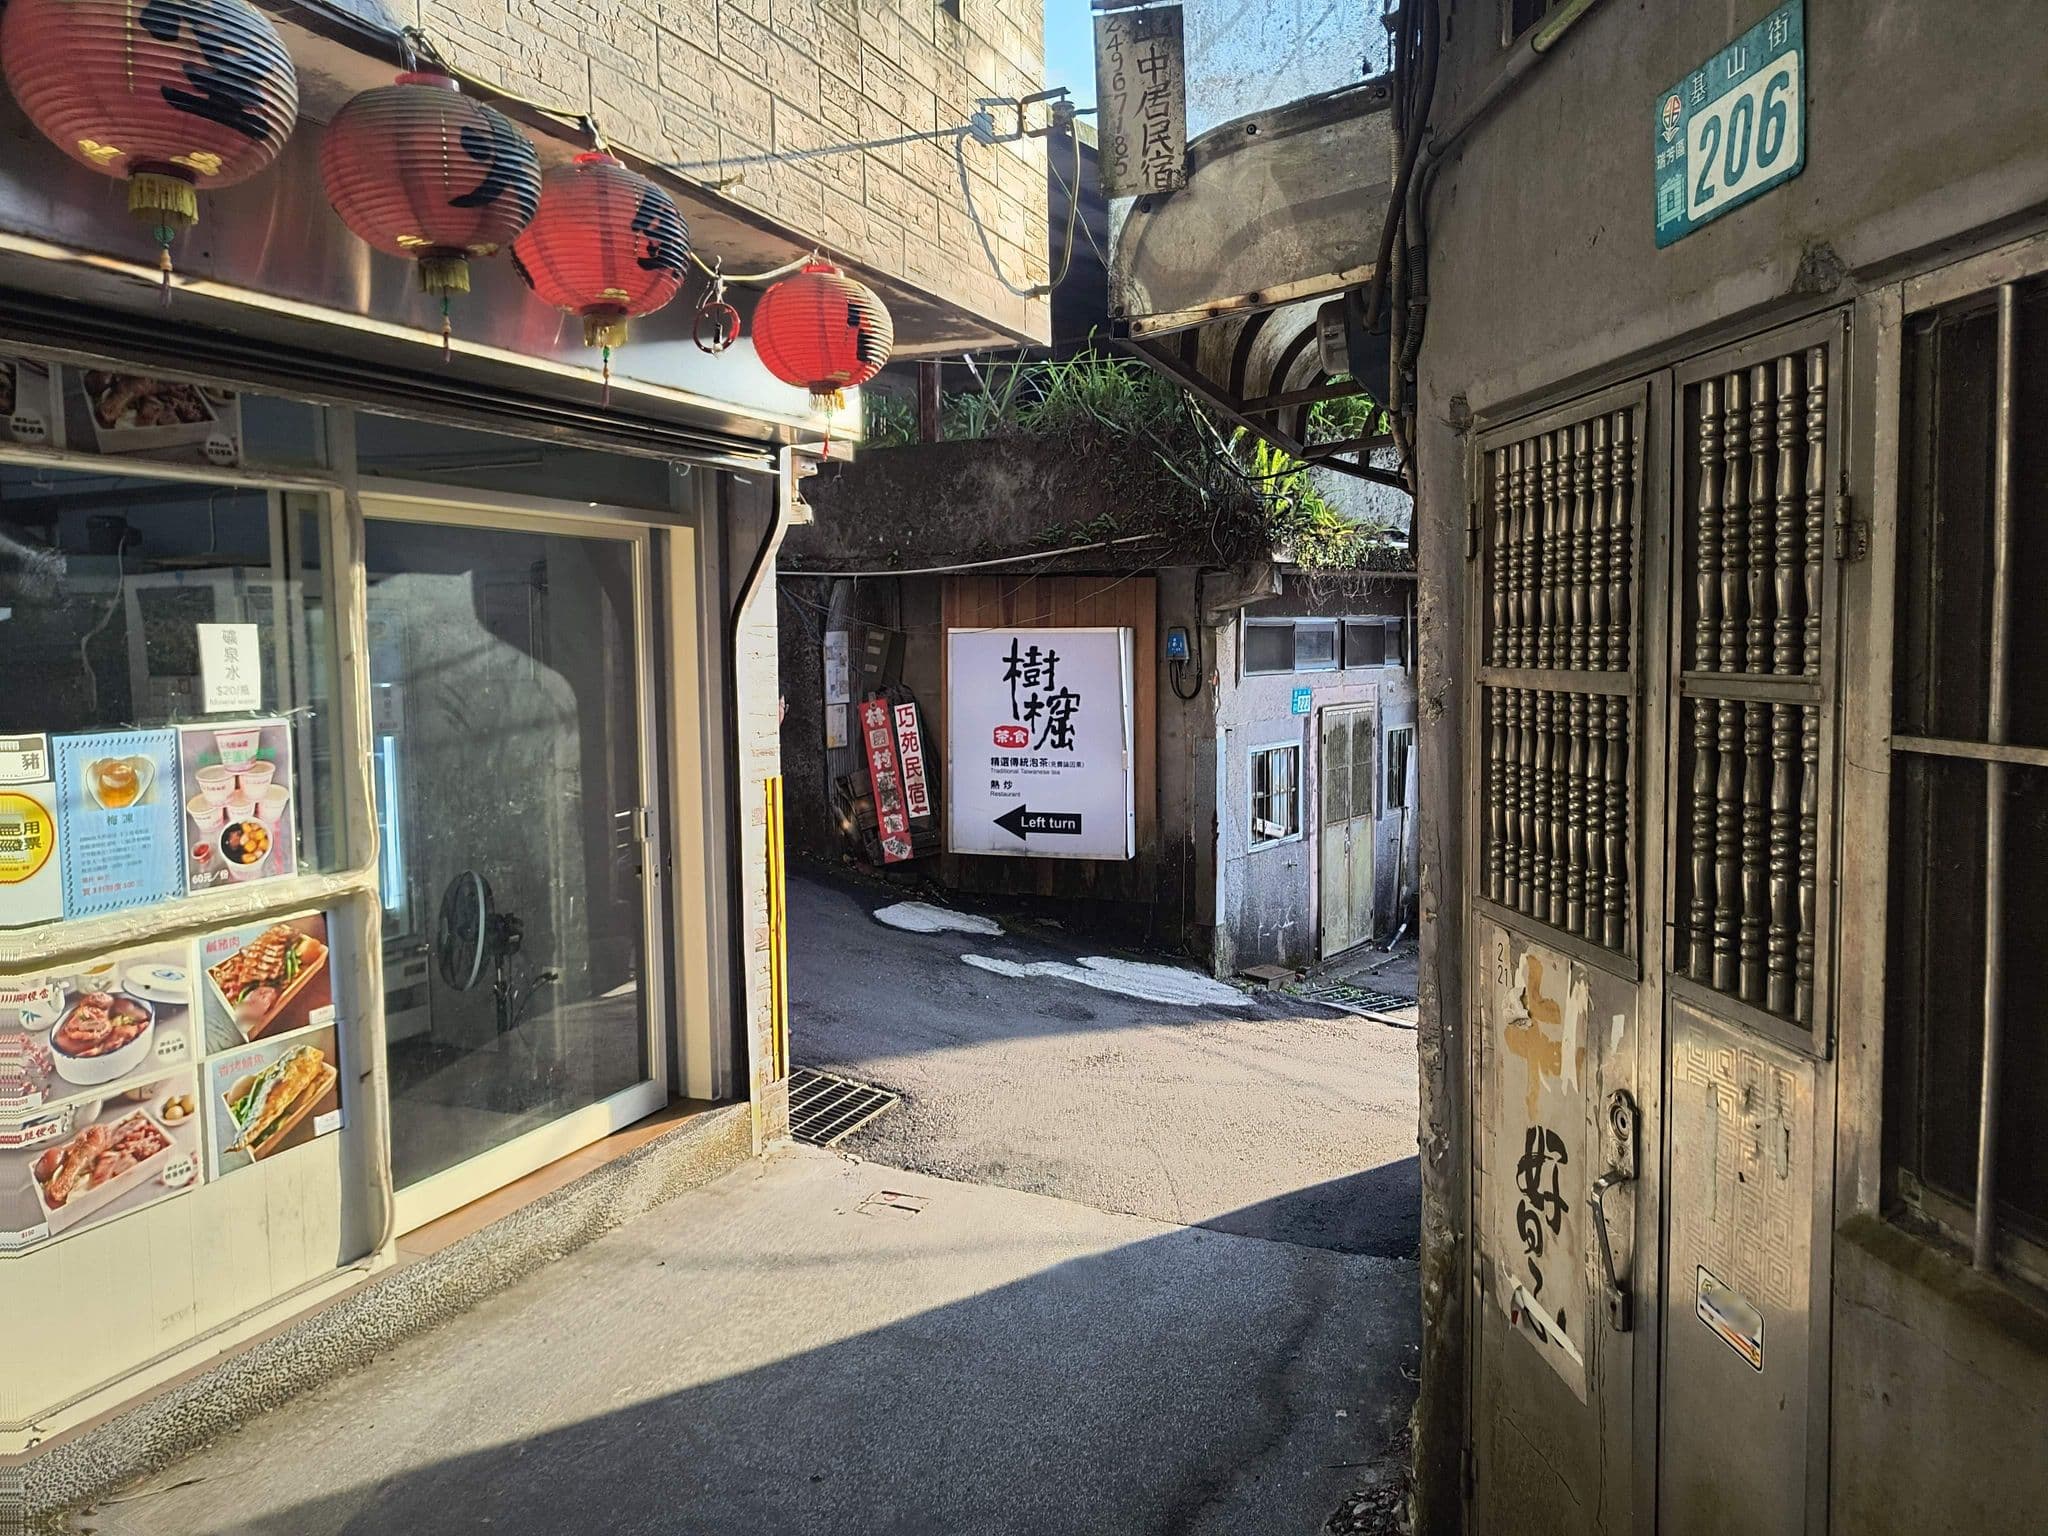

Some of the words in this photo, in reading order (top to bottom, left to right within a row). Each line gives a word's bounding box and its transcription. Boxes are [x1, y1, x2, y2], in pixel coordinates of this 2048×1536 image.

[1691, 12, 1789, 106] 基山街
[1656, 138, 1686, 170] 瑞芳區
[1694, 70, 1790, 208] 206
[895, 706, 925, 805] 巧苑民宿
[1021, 816, 1046, 829] Left
[1049, 817, 1076, 830] turn
